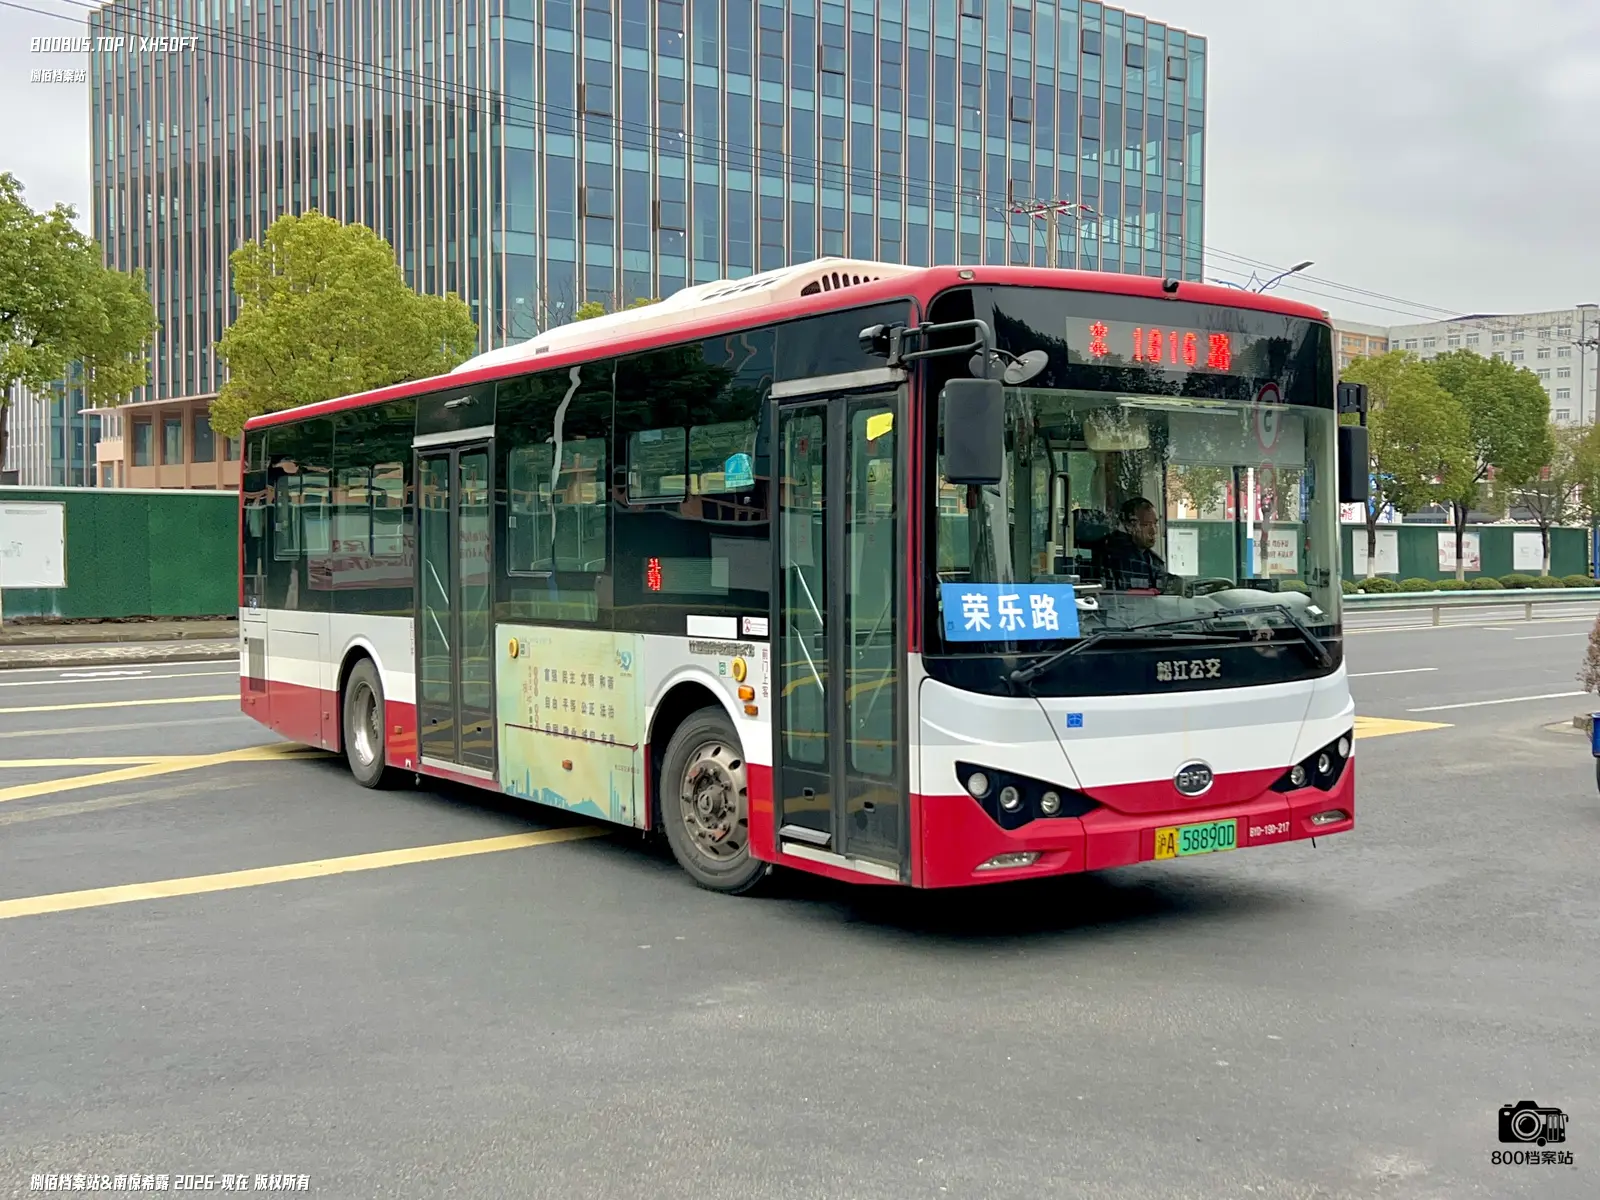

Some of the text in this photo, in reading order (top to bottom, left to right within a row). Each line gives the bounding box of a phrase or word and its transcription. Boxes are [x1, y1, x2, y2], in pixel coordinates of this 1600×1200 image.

[961, 592, 1060, 632] 荣乐路
[1179, 770, 1210, 787] BYD
